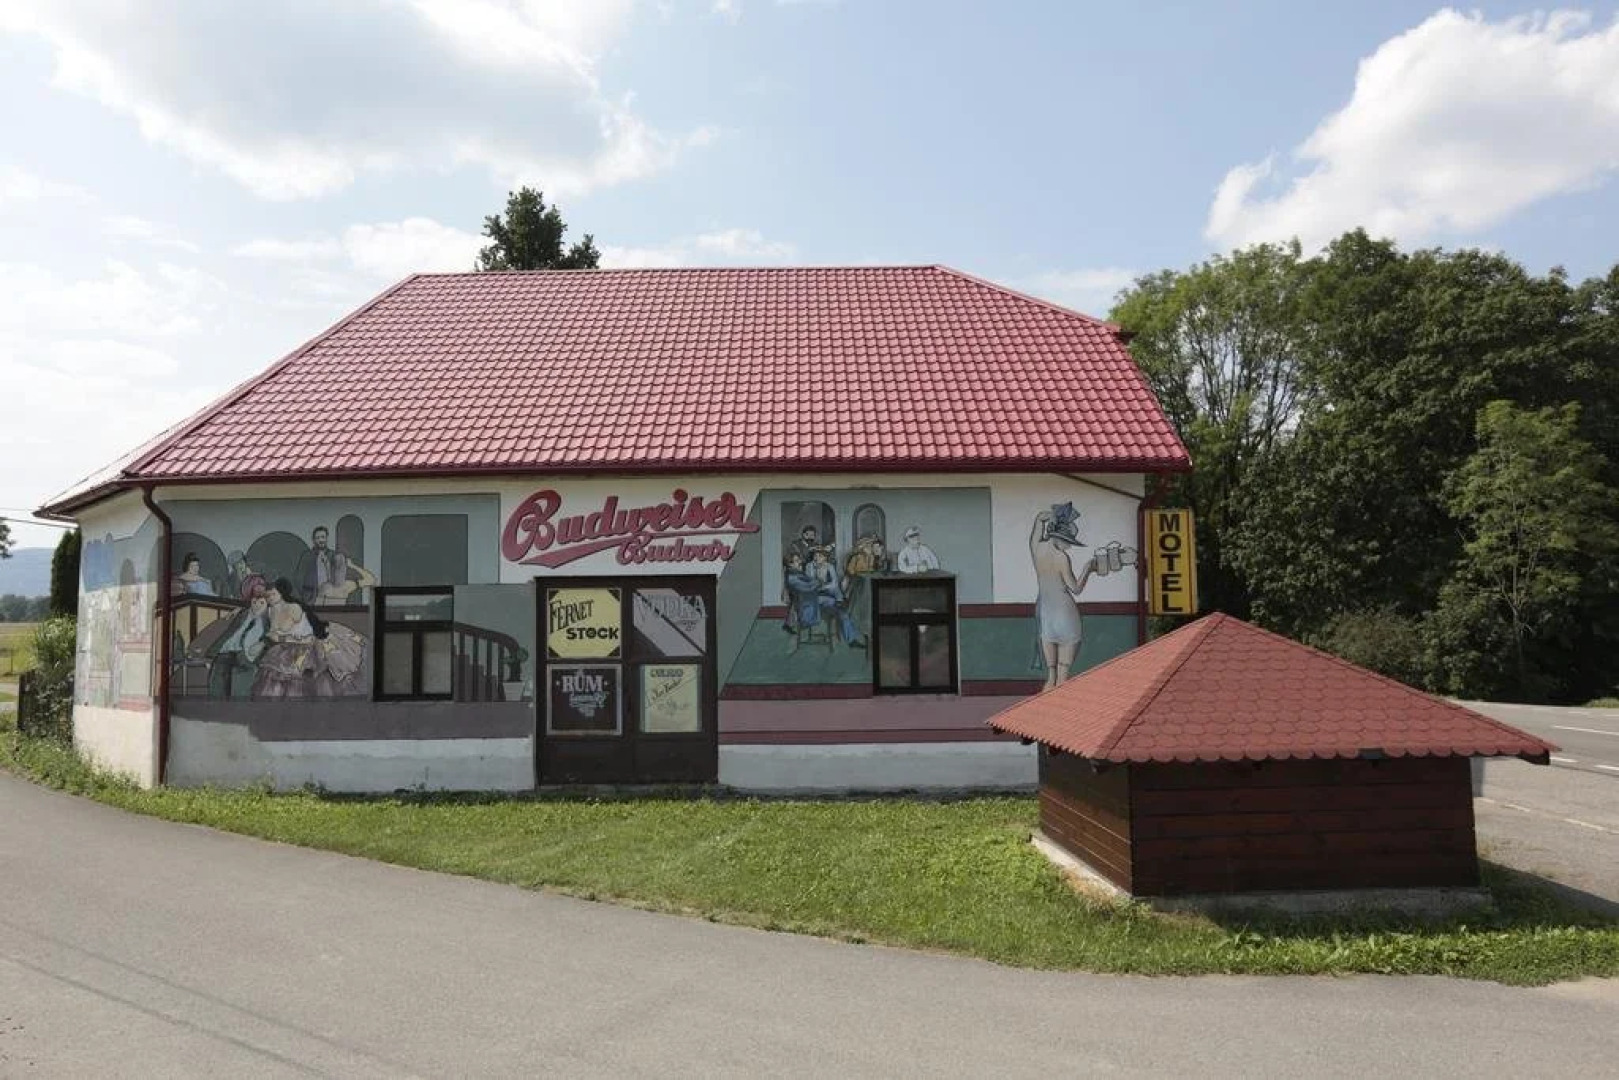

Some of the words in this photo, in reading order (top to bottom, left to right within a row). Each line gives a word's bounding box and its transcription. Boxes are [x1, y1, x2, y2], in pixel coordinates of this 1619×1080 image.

[502, 489, 760, 562] Budweiser
[1159, 513, 1183, 612] MOTEL
[548, 599, 594, 634] FERNET
[566, 626, 619, 640] STOCK
[561, 675, 604, 692] RUM
